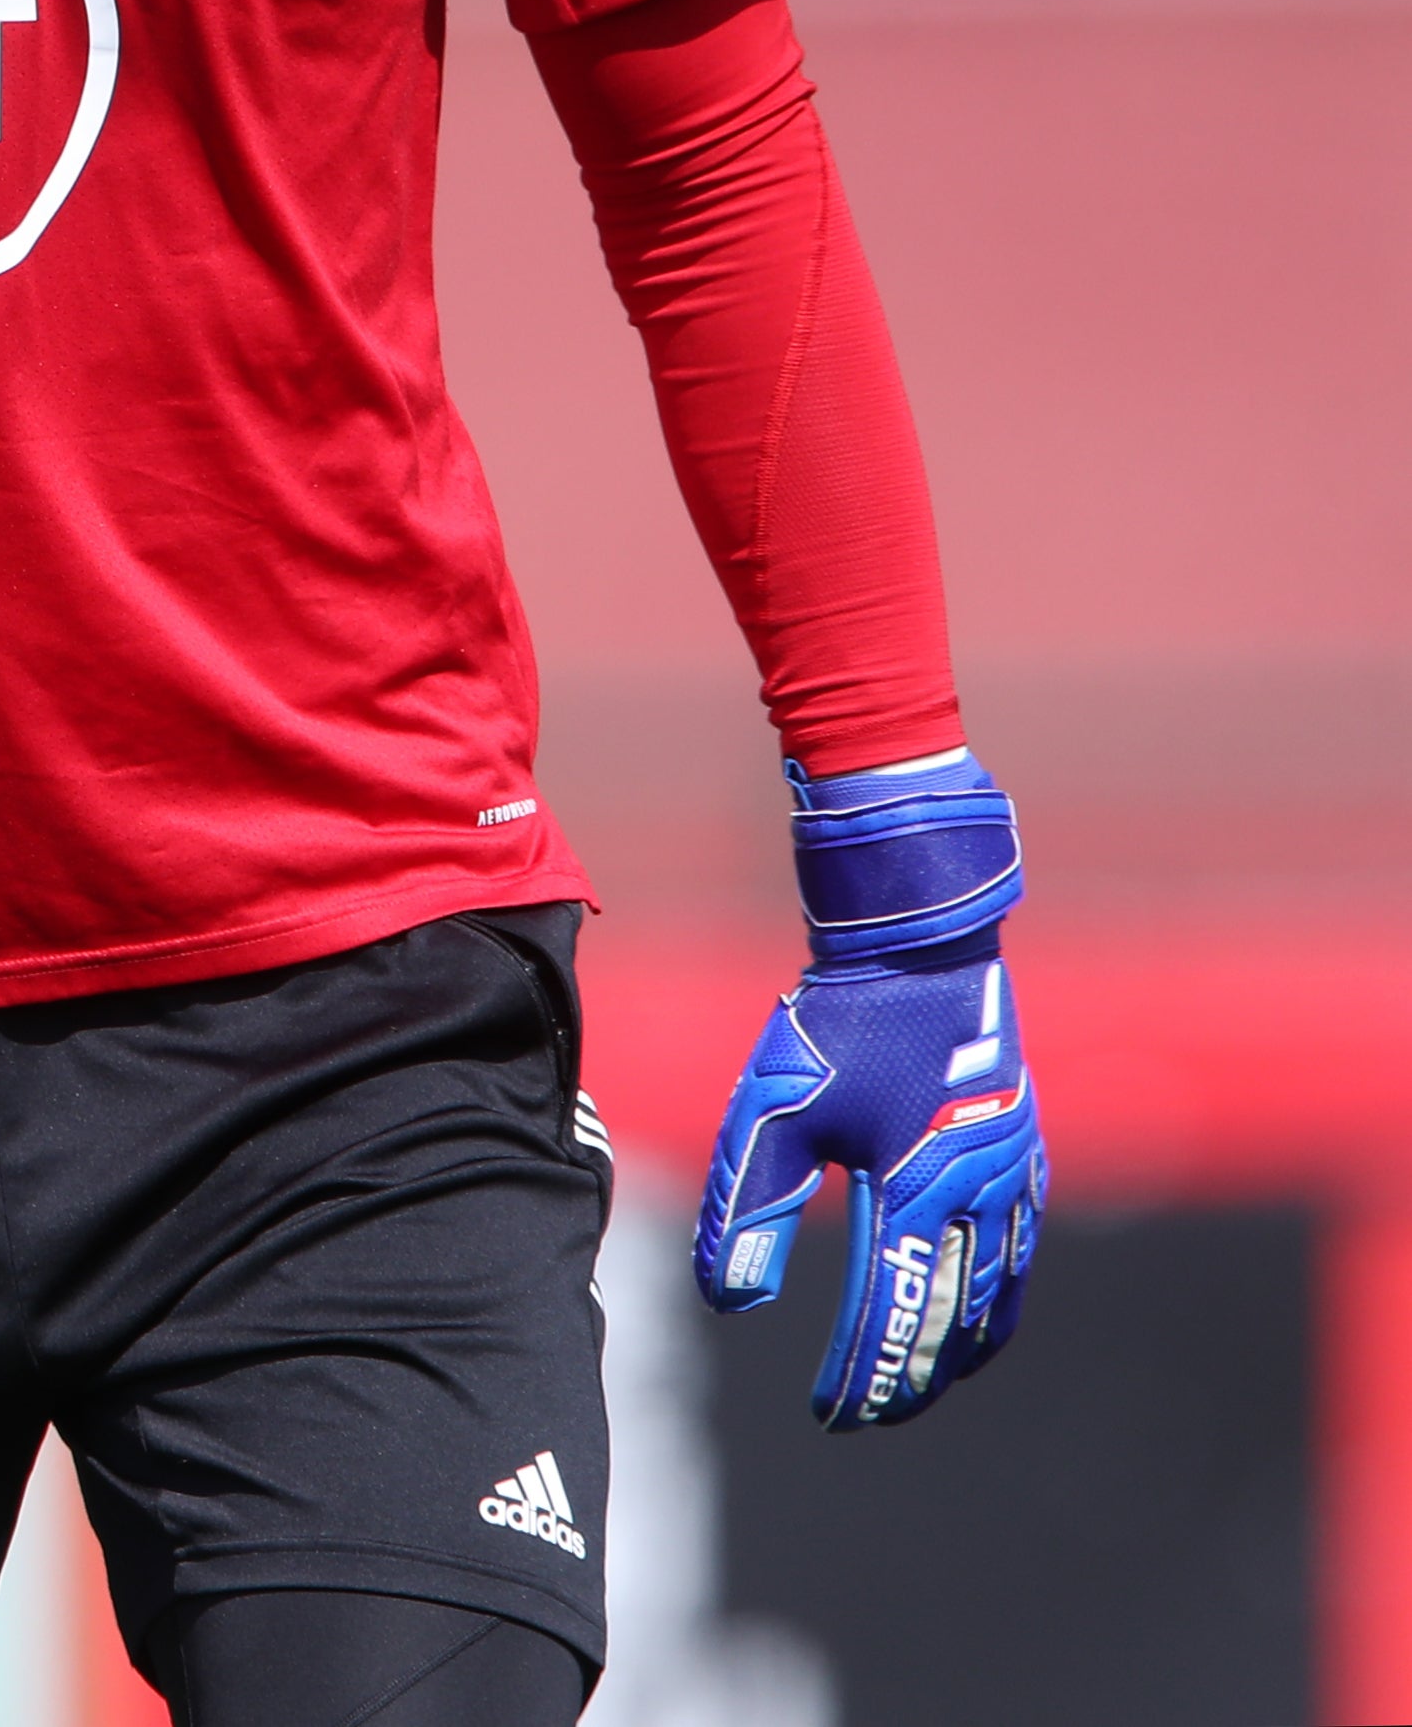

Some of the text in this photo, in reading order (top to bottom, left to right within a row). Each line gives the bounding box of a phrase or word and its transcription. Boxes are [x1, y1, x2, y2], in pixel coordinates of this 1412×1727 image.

[733, 1240, 753, 1269] GOLD
[857, 1235, 934, 1423] reusch
[478, 1495, 586, 1560] adidas
